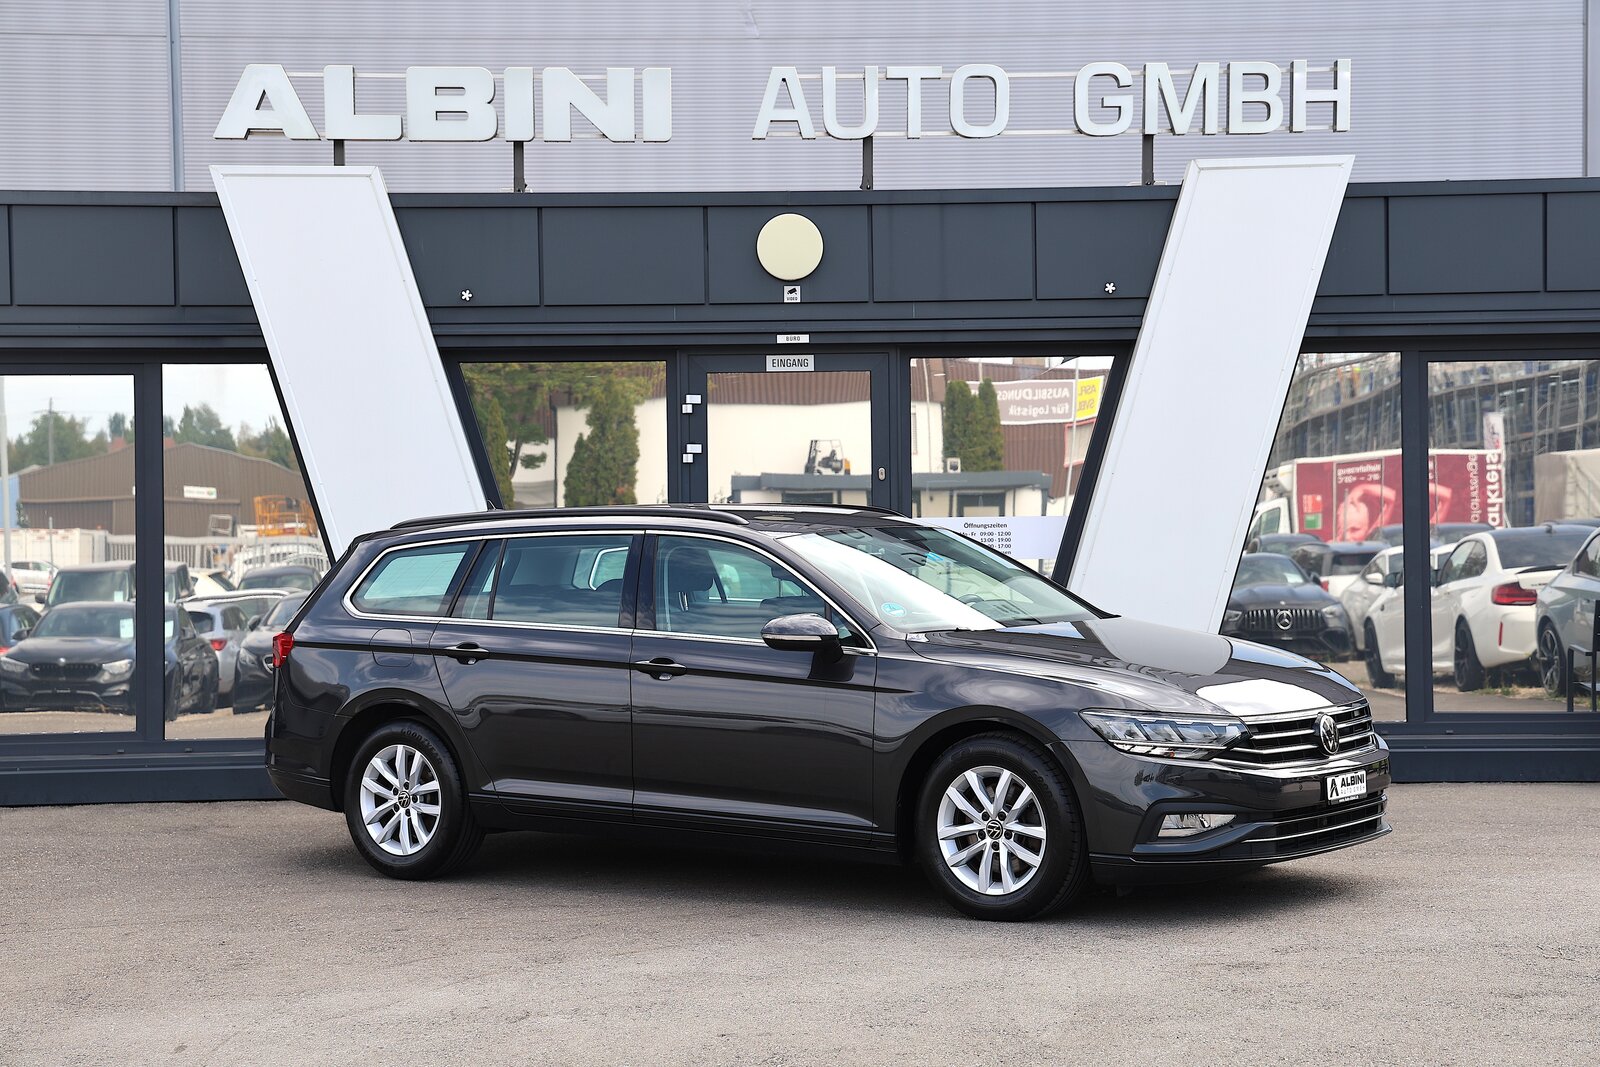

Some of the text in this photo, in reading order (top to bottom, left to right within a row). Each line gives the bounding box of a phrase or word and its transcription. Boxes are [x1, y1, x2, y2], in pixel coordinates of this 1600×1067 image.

[213, 59, 1352, 142] ALBINI AUTO GMBH
[771, 358, 809, 368] EINGANG
[1340, 773, 1365, 788] ALBINI
